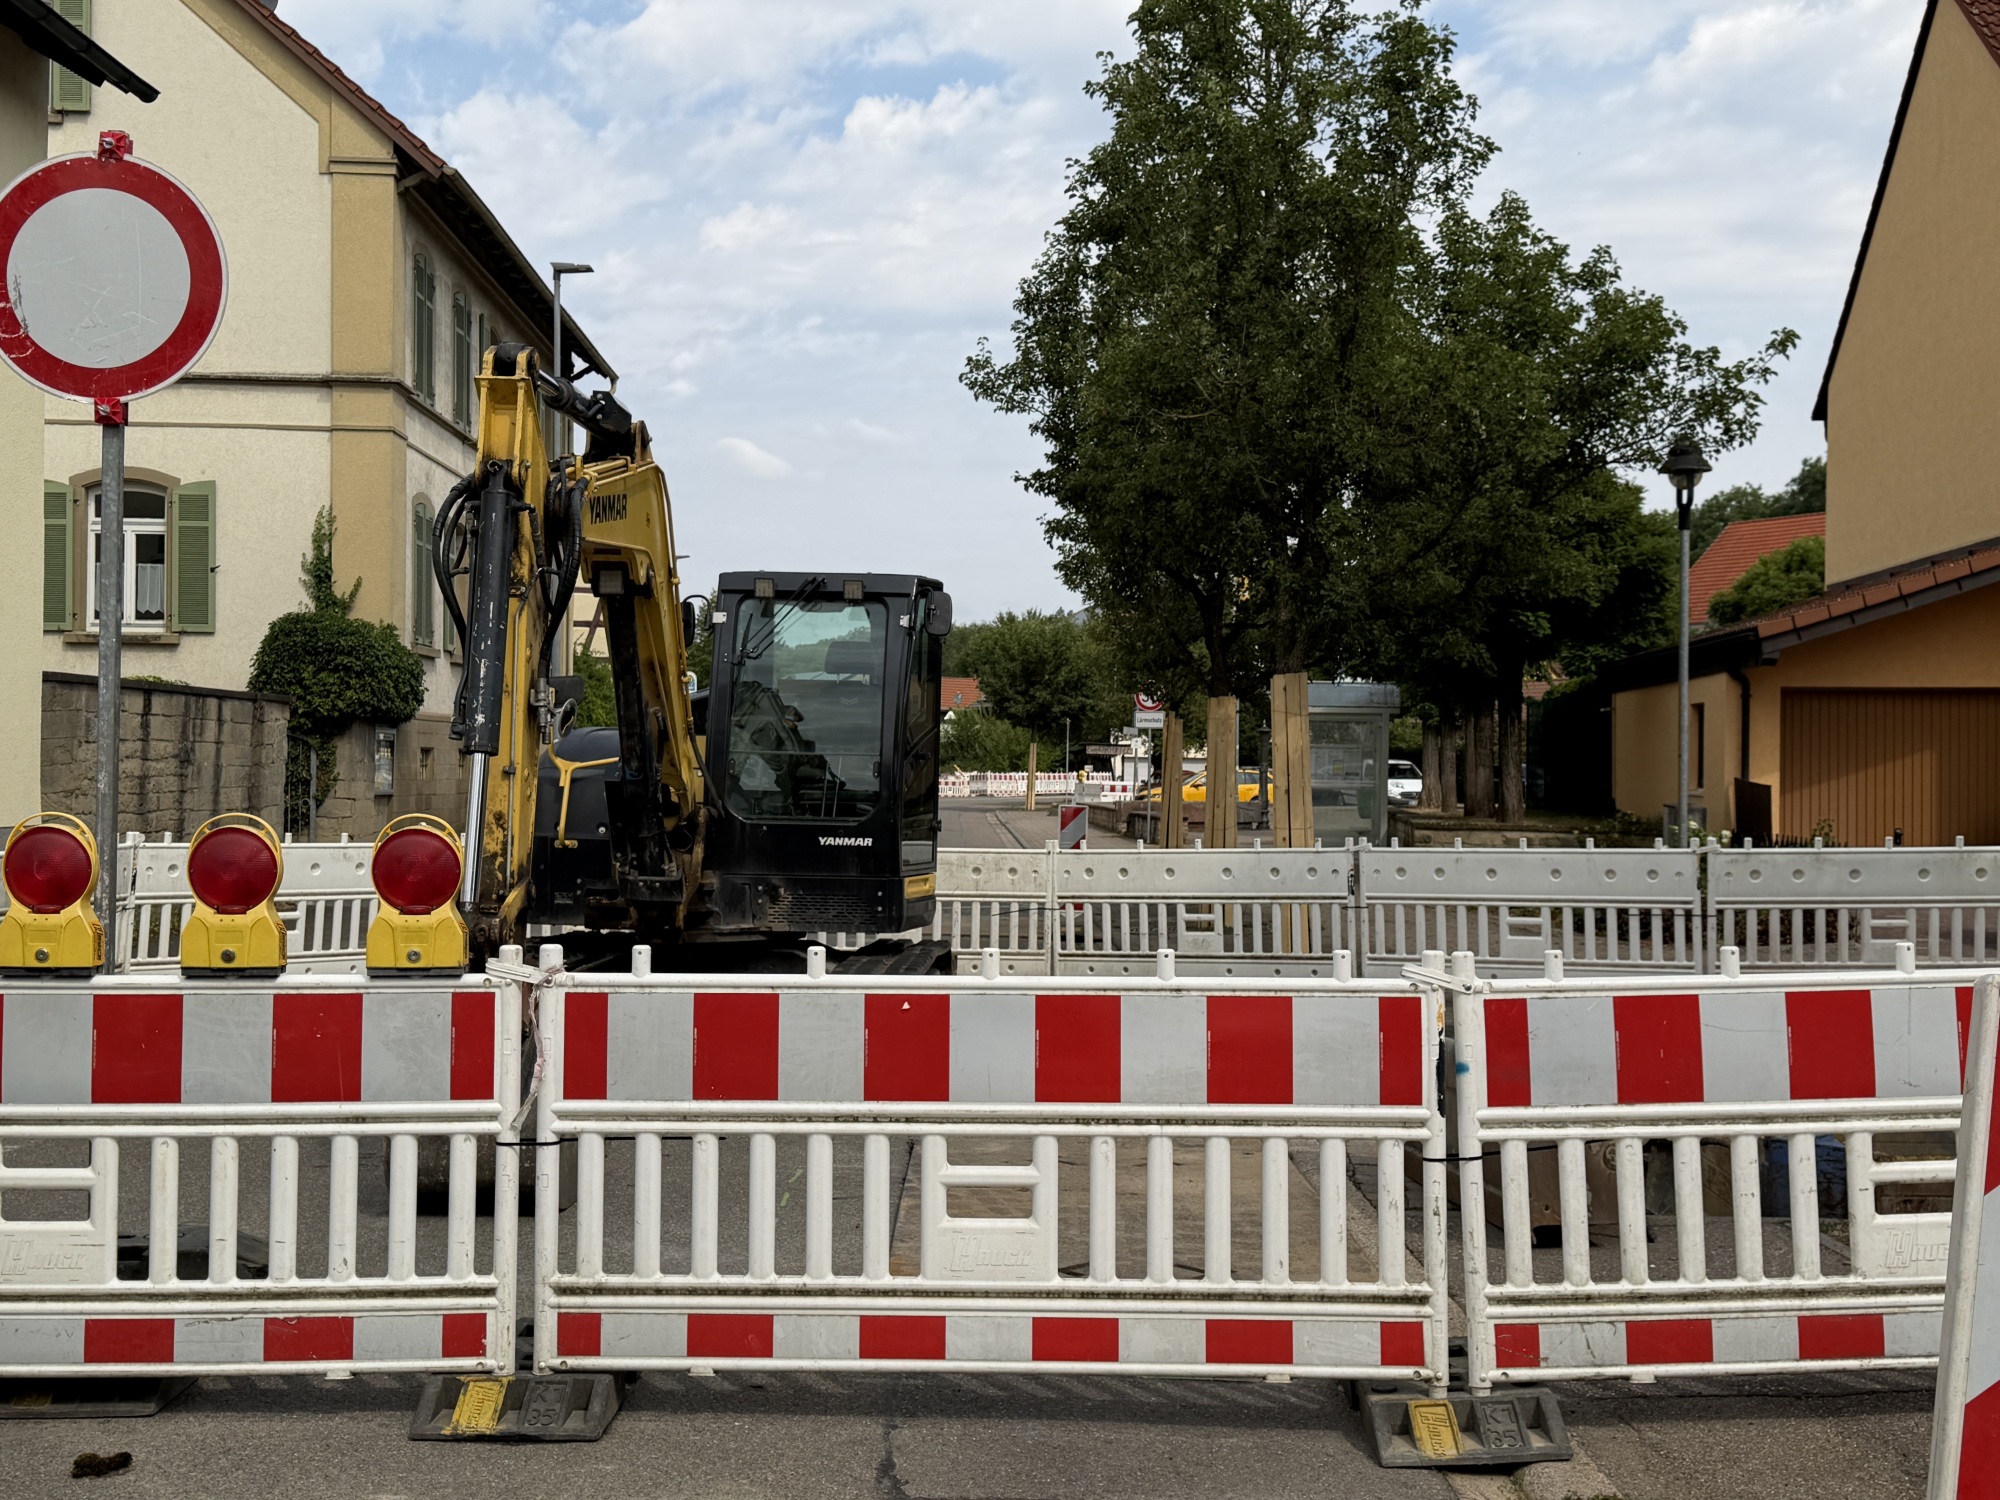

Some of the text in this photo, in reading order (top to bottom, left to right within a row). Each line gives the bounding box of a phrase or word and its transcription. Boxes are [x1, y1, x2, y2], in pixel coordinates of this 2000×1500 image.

[590, 494, 627, 525] YANMAR
[818, 836, 873, 847] YANMAR
[526, 1408, 557, 1426] 35
